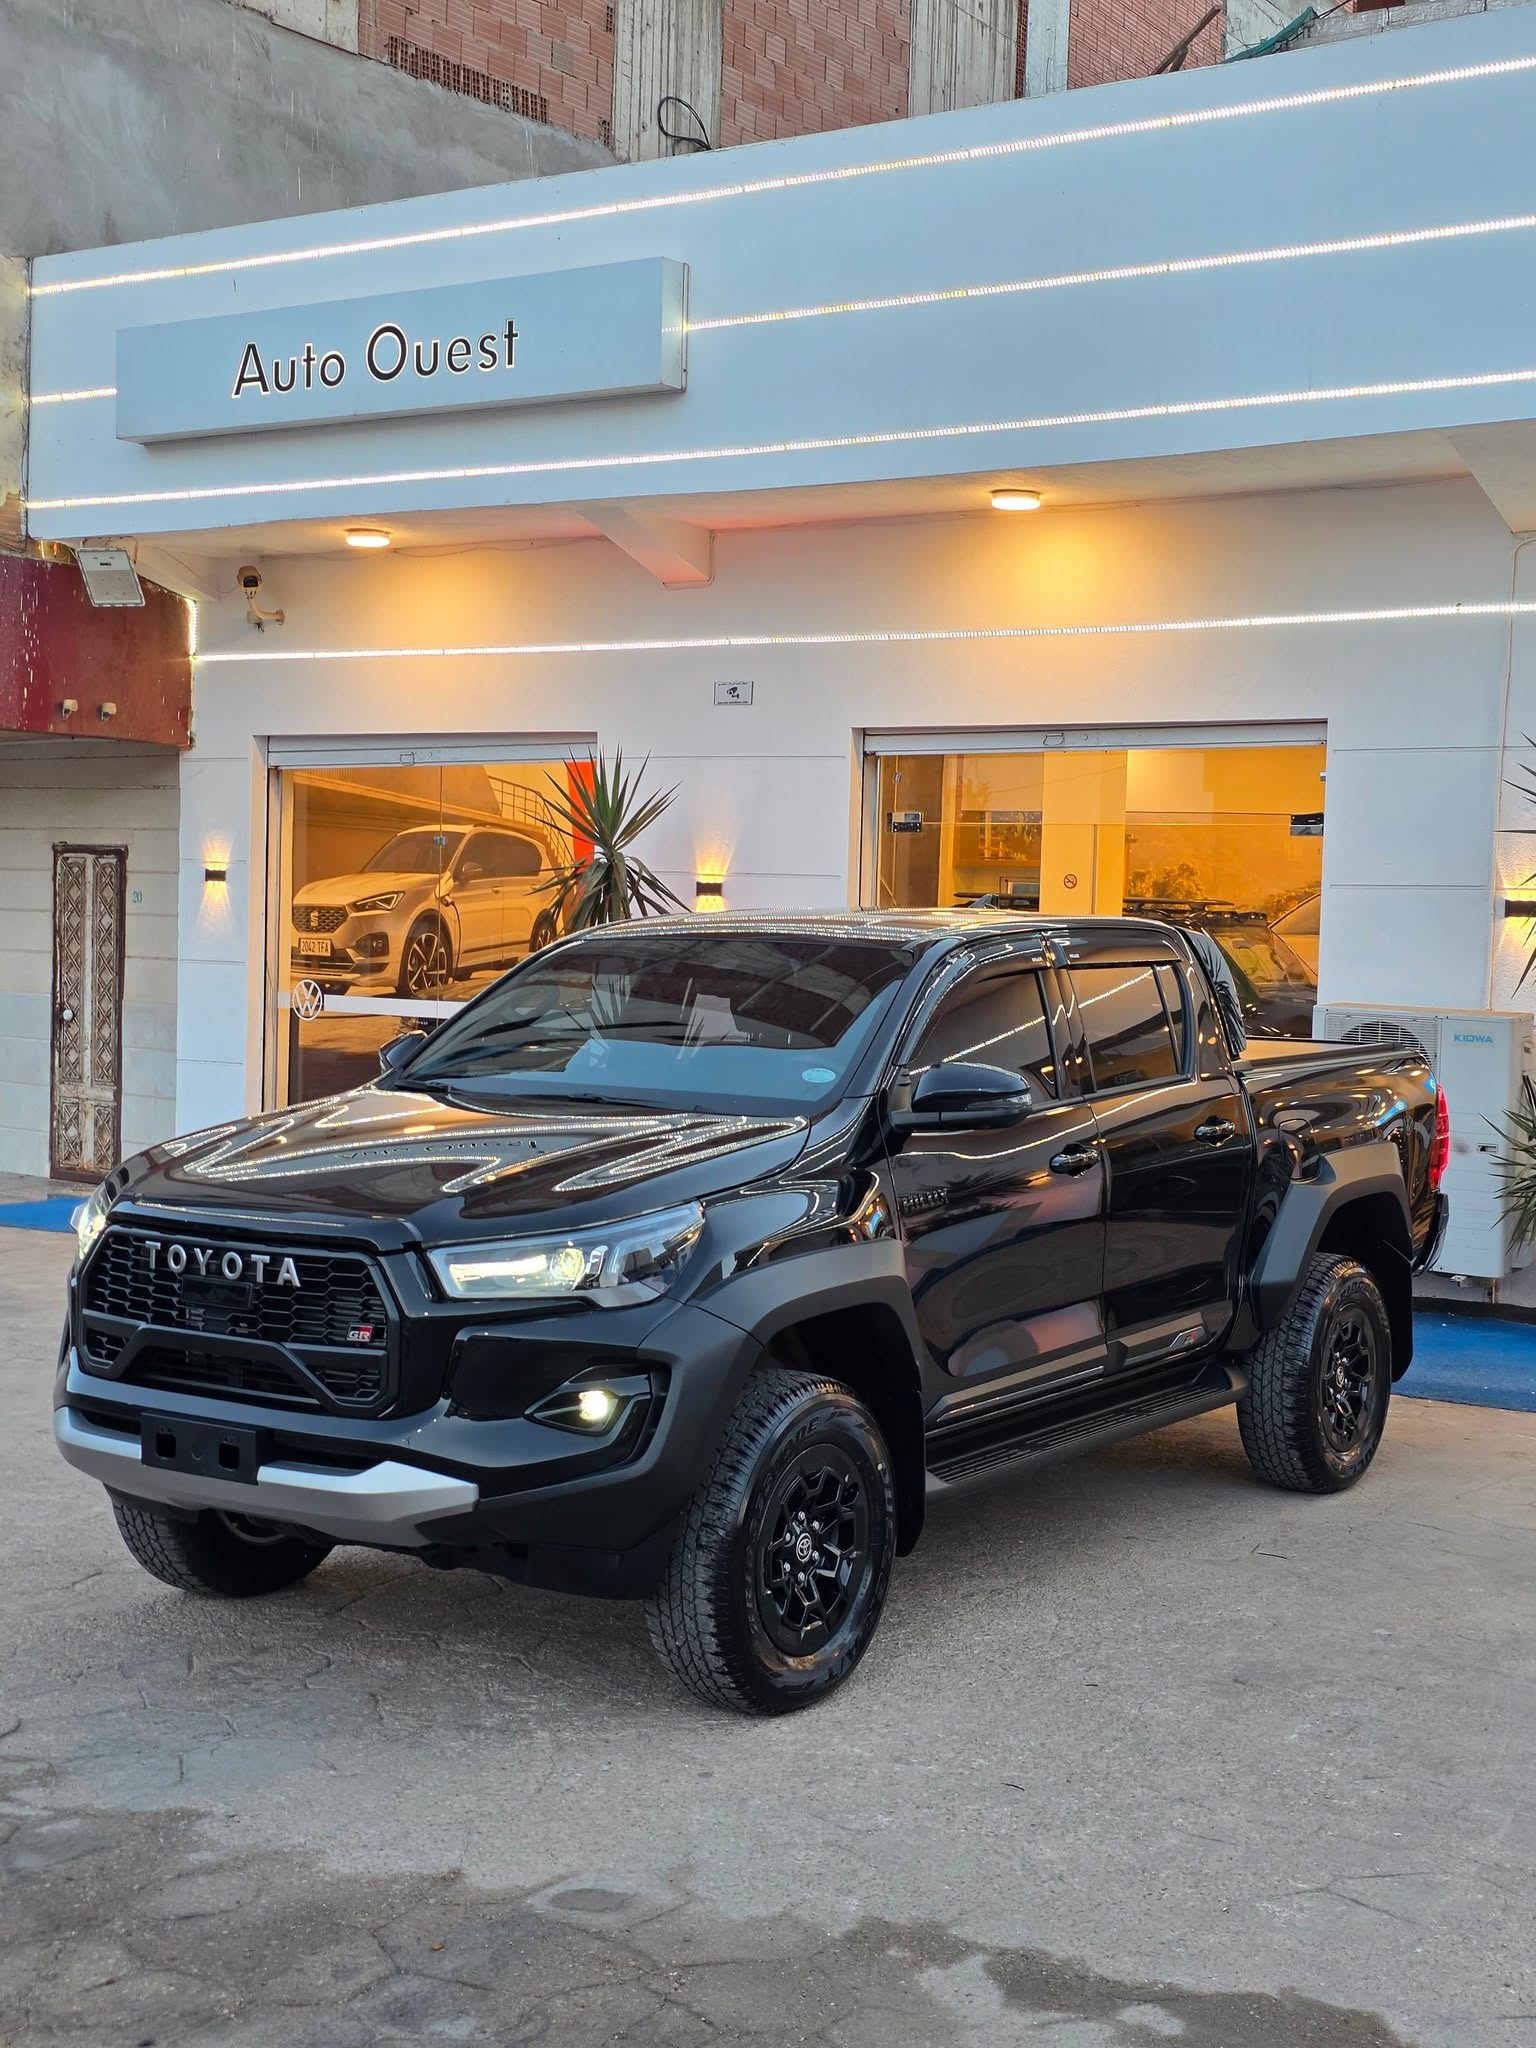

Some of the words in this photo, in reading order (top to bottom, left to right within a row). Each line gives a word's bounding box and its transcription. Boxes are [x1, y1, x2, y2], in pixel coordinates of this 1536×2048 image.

[231, 341, 346, 399] Auto
[365, 318, 519, 383] Ouest
[145, 1240, 301, 1288] TOYOTA
[348, 1330, 371, 1341] GR
